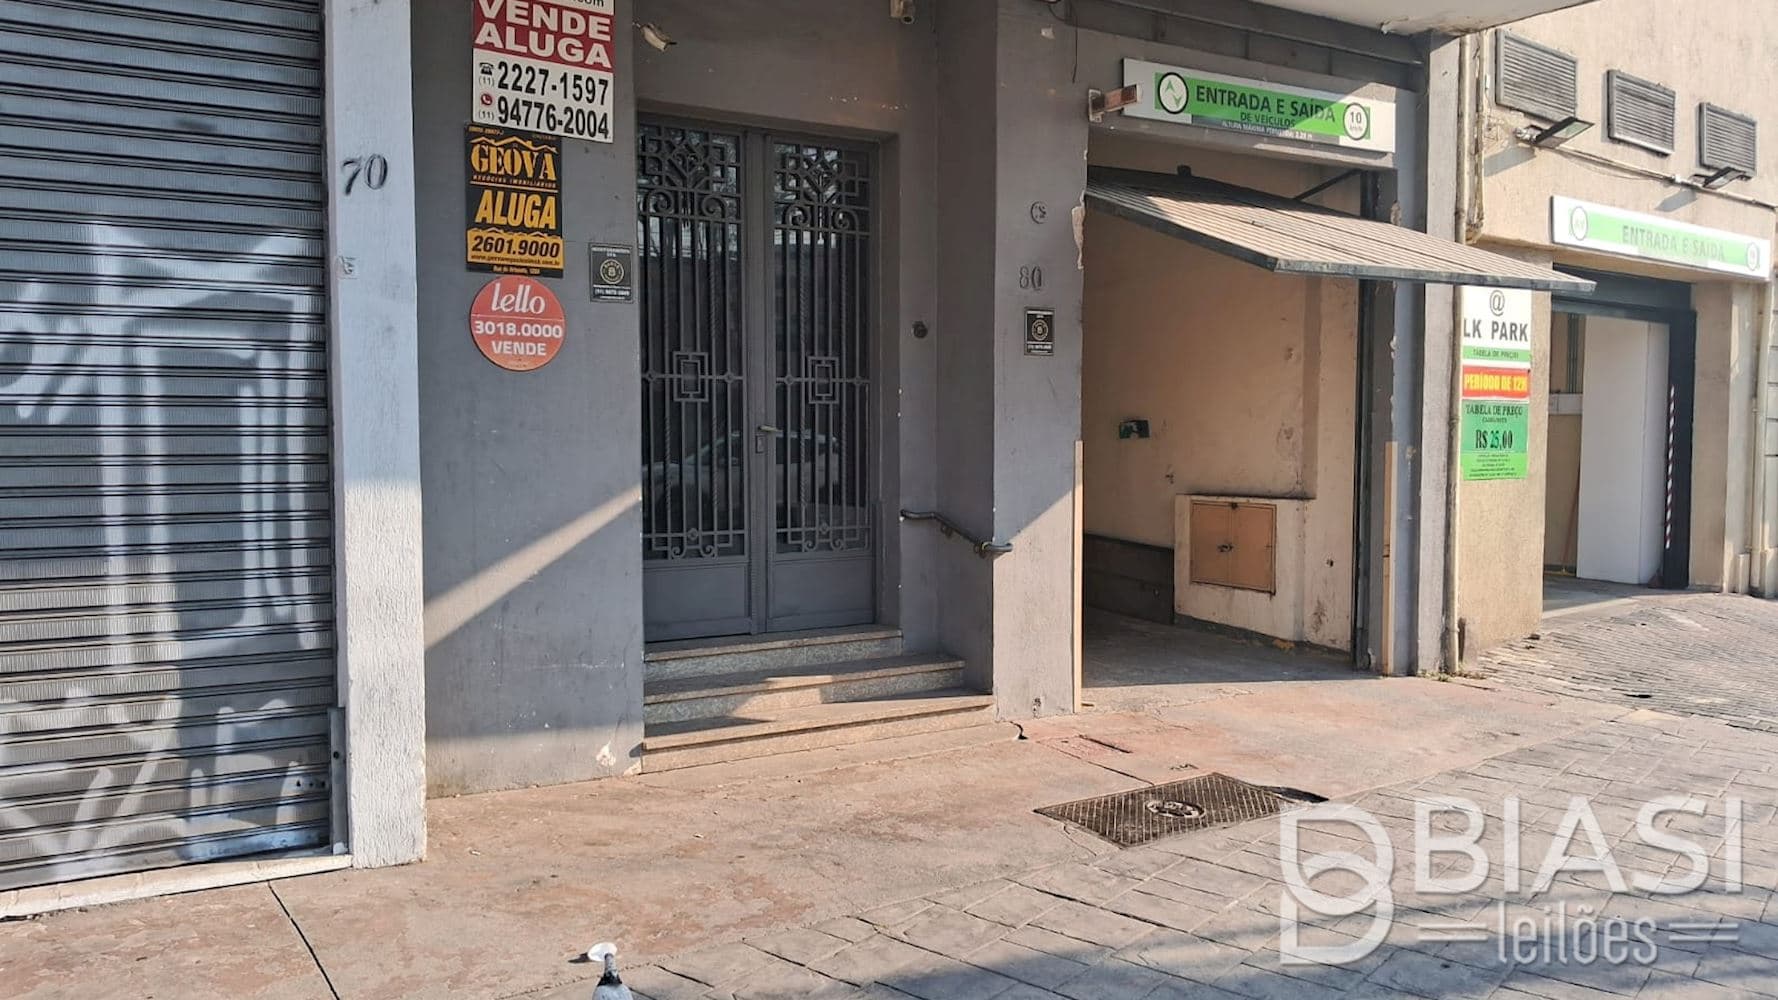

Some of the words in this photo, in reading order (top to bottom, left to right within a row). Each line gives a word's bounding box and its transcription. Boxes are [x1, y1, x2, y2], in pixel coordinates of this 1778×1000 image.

[479, 0, 611, 42] VENDE
[474, 22, 612, 69] ALUGA
[478, 76, 495, 88] (11)
[497, 61, 609, 106] 2227-1597
[478, 110, 495, 121] (11)
[497, 96, 609, 139] 94776-2004
[1196, 85, 1272, 112] ENTRADA
[1276, 98, 1285, 115] E
[1290, 98, 1335, 123] SAÍDA
[1241, 112, 1253, 122] DE
[1350, 111, 1362, 124] 10
[342, 154, 388, 195] 70
[471, 144, 556, 180] GEOVA
[475, 189, 556, 229] ALUGA
[472, 235, 560, 258] 2601.9000
[1622, 225, 1677, 252] ENTRADA
[1682, 238, 1689, 254] E
[1019, 266, 1042, 290] 80
[491, 282, 546, 314] lello
[1489, 289, 1506, 316] @
[474, 320, 562, 338] 3018.0000
[1463, 318, 1482, 338] LK
[1491, 320, 1528, 342] PARK
[491, 340, 547, 356] VENDE
[1466, 404, 1492, 415] TABELA
[1493, 406, 1501, 416] DE
[1502, 406, 1522, 418] PREÇO
[1490, 430, 1513, 450] 25,00
